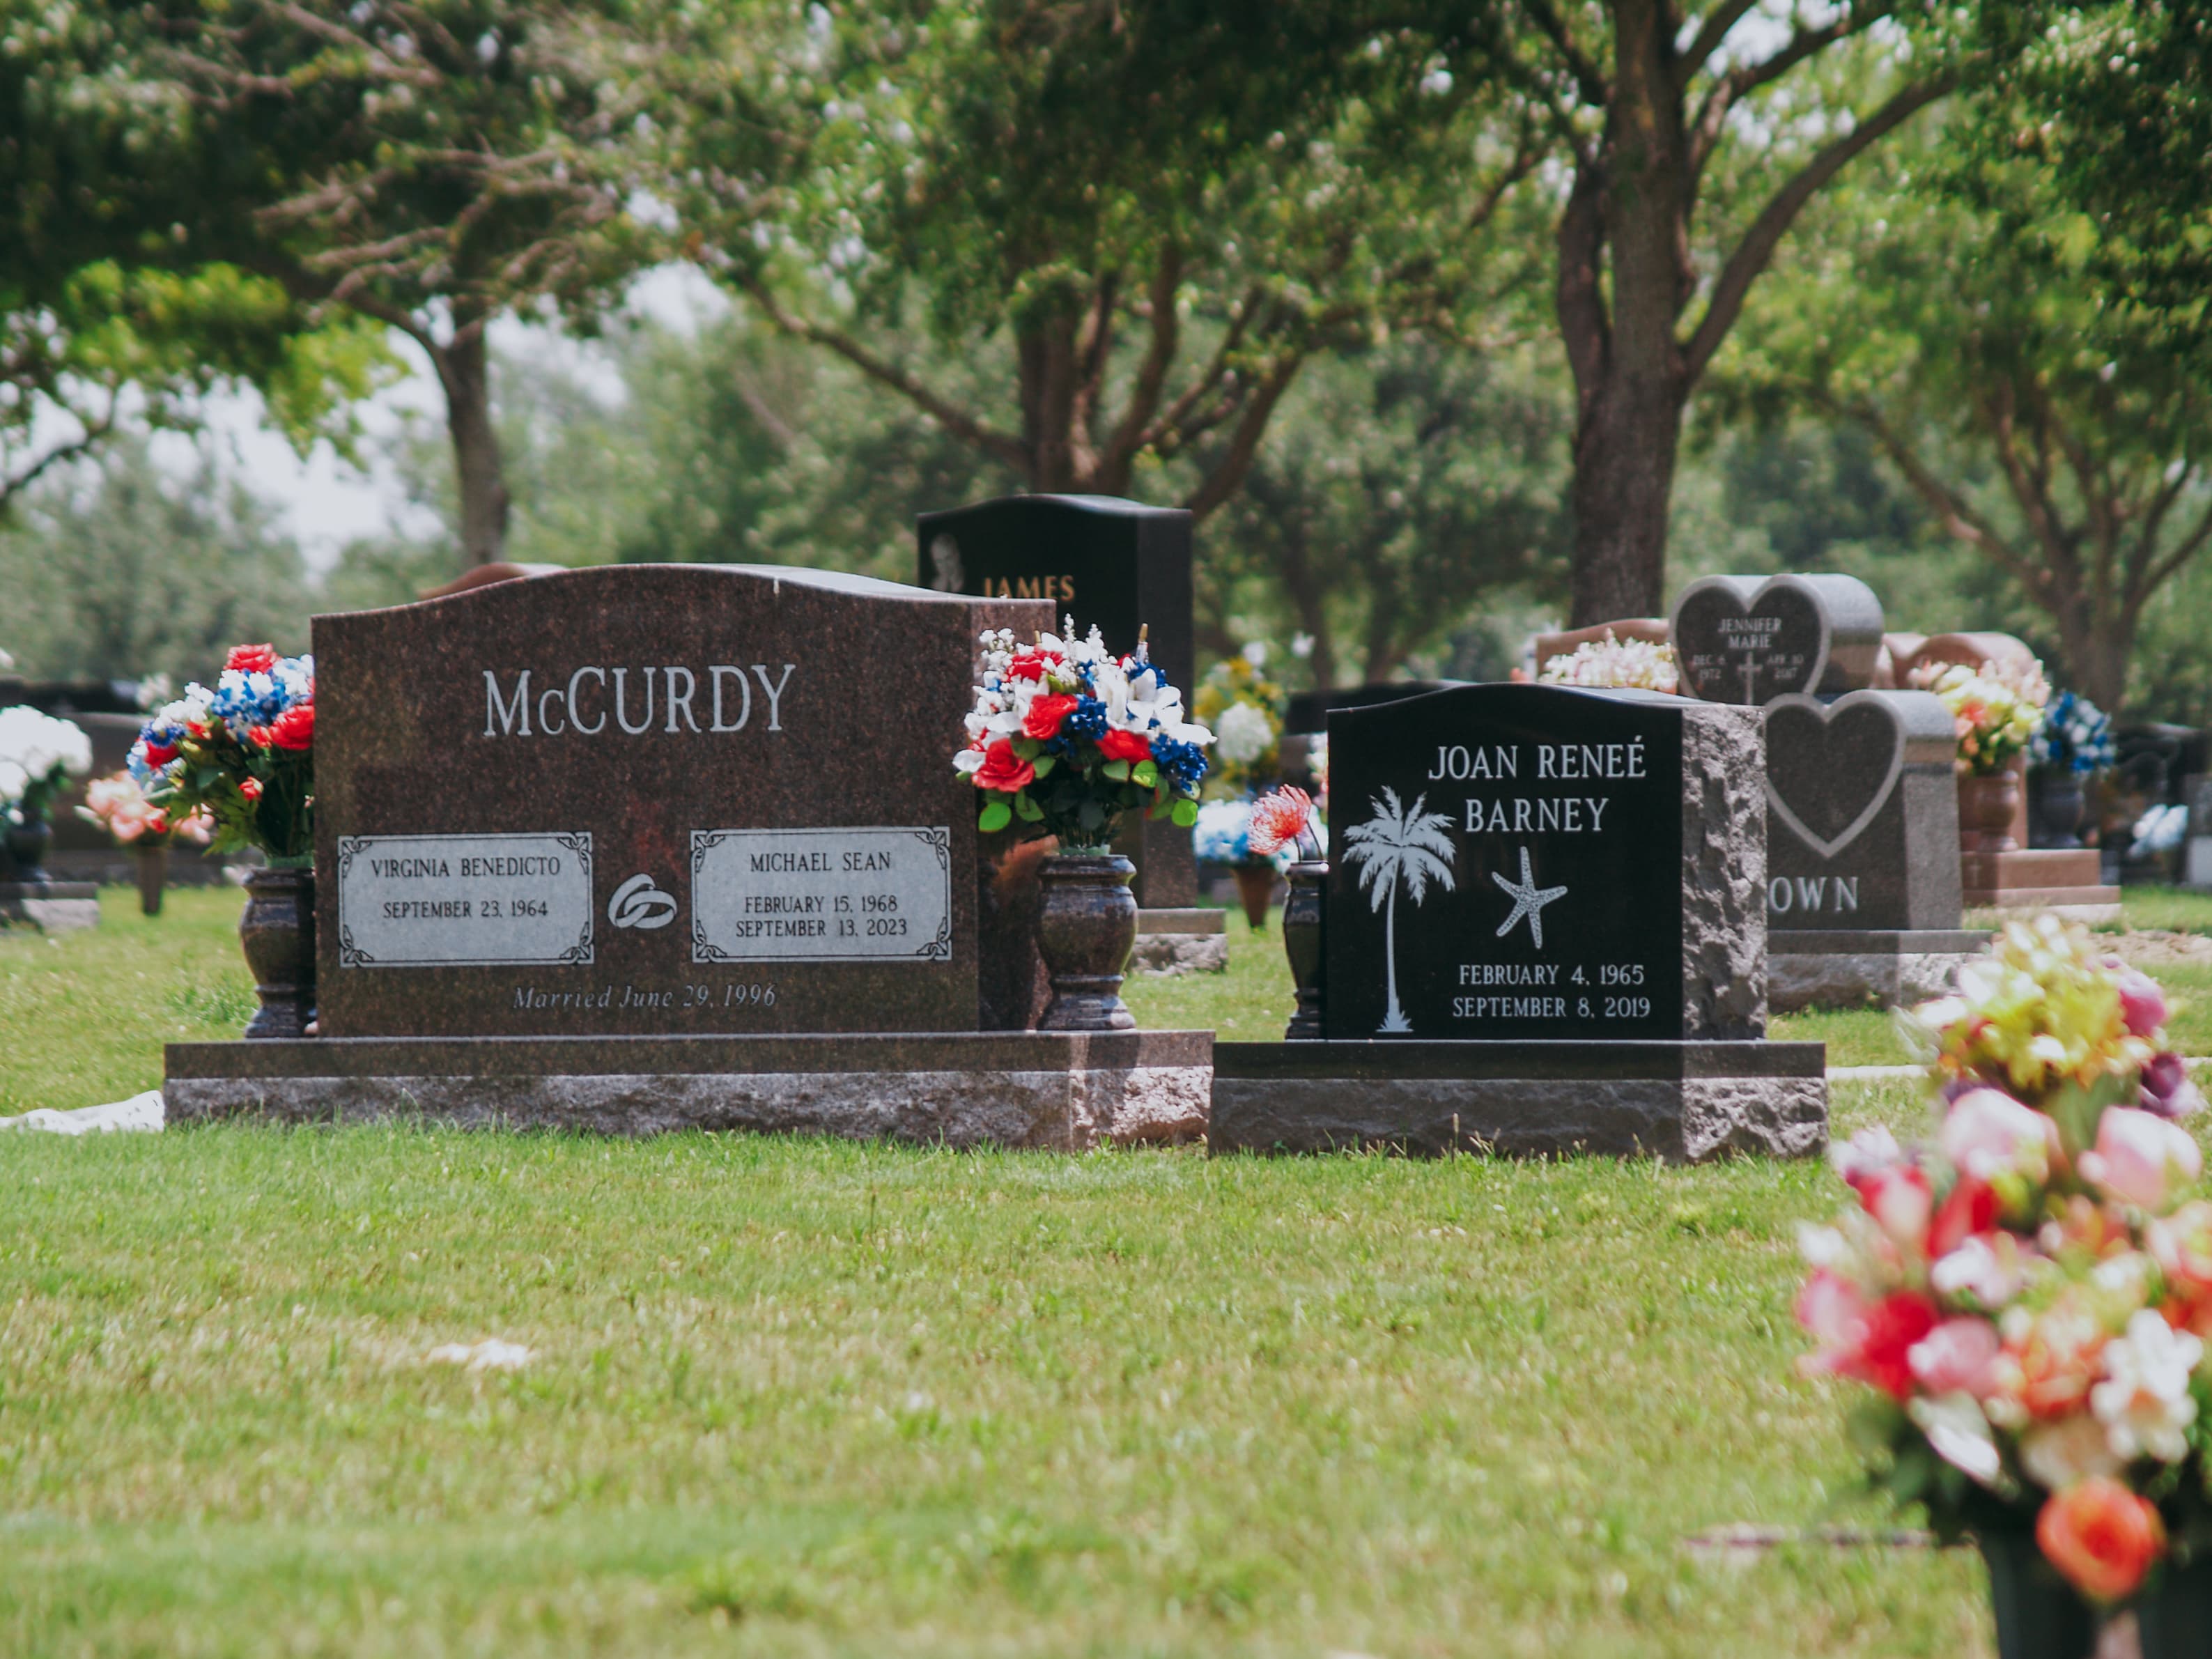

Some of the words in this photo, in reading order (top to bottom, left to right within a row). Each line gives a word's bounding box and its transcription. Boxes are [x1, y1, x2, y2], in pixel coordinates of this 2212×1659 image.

[984, 575, 1075, 601] JAMES
[1717, 617, 1782, 633] JENNIFER
[1728, 634, 1772, 649] MARIE
[482, 664, 796, 738] McCURDY
[1428, 746, 1517, 780] JOAN
[1538, 736, 1646, 778] RENEÉ
[1465, 798, 1608, 832] BARNEY
[372, 858, 450, 878] VIRGINIA
[461, 856, 561, 877] BENEDICTO
[750, 852, 832, 872] MICHAEL
[842, 852, 891, 871] SEAN
[383, 901, 472, 919] SEPTEMBER
[481, 901, 503, 918] 23,
[511, 900, 549, 917] 1964
[745, 896, 825, 913] FEBRUARY
[833, 896, 853, 913] 15,
[861, 895, 897, 912] 1968
[736, 920, 826, 937] SEPTEMBER
[838, 920, 858, 937] 13,
[867, 918, 907, 936] 2023
[1459, 964, 1559, 985] FEBRUARY
[1570, 965, 1590, 986] 4,
[1599, 964, 1645, 985] 1965
[513, 986, 612, 1009] Married
[619, 985, 673, 1008] June
[683, 984, 714, 1008] 29,
[724, 983, 777, 1007] 1996
[1453, 997, 1566, 1018] SEPTEMBER
[1577, 997, 1595, 1019] 8,
[1604, 996, 1650, 1017] 2019
